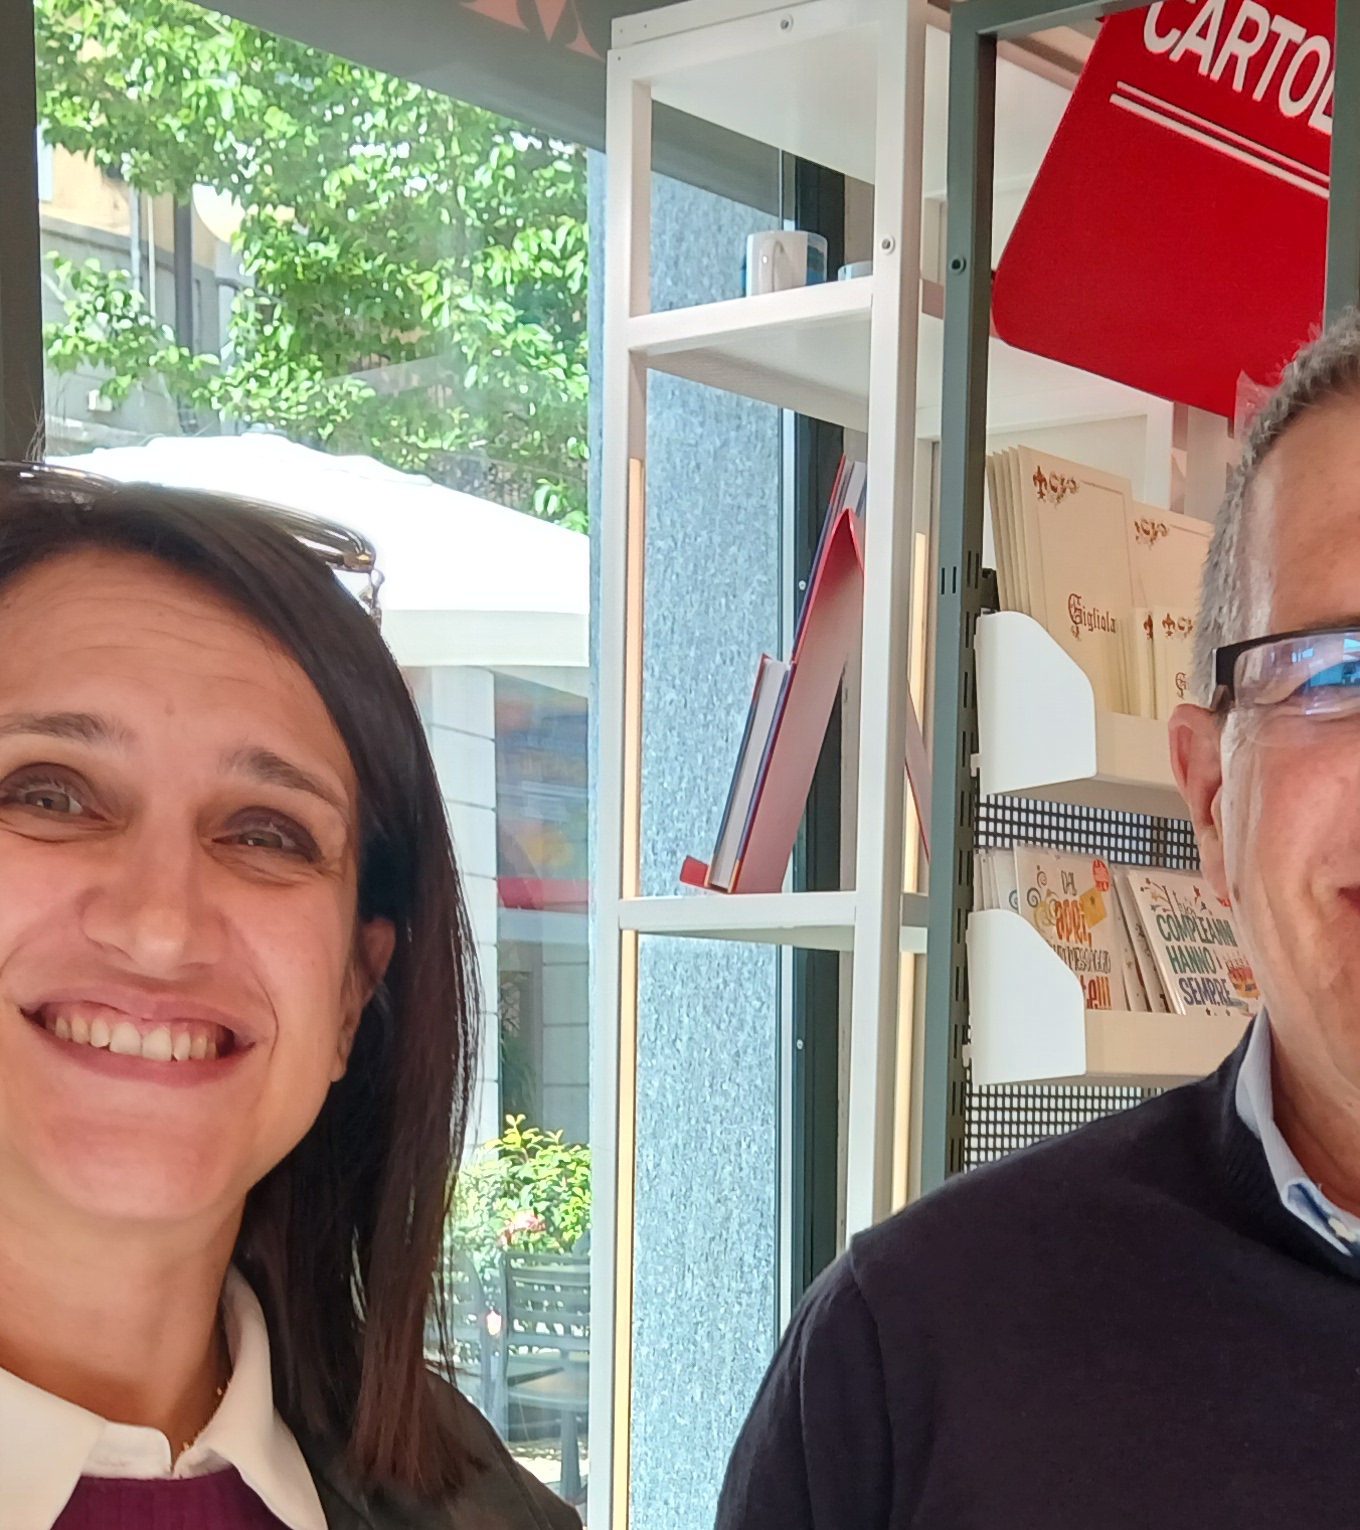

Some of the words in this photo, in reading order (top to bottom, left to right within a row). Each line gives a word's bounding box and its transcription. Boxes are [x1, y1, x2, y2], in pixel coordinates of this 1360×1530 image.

[1068, 593, 1117, 640] Gigliola
[1166, 945, 1217, 975] HANNO
[1178, 976, 1235, 1006] SEMPRE
